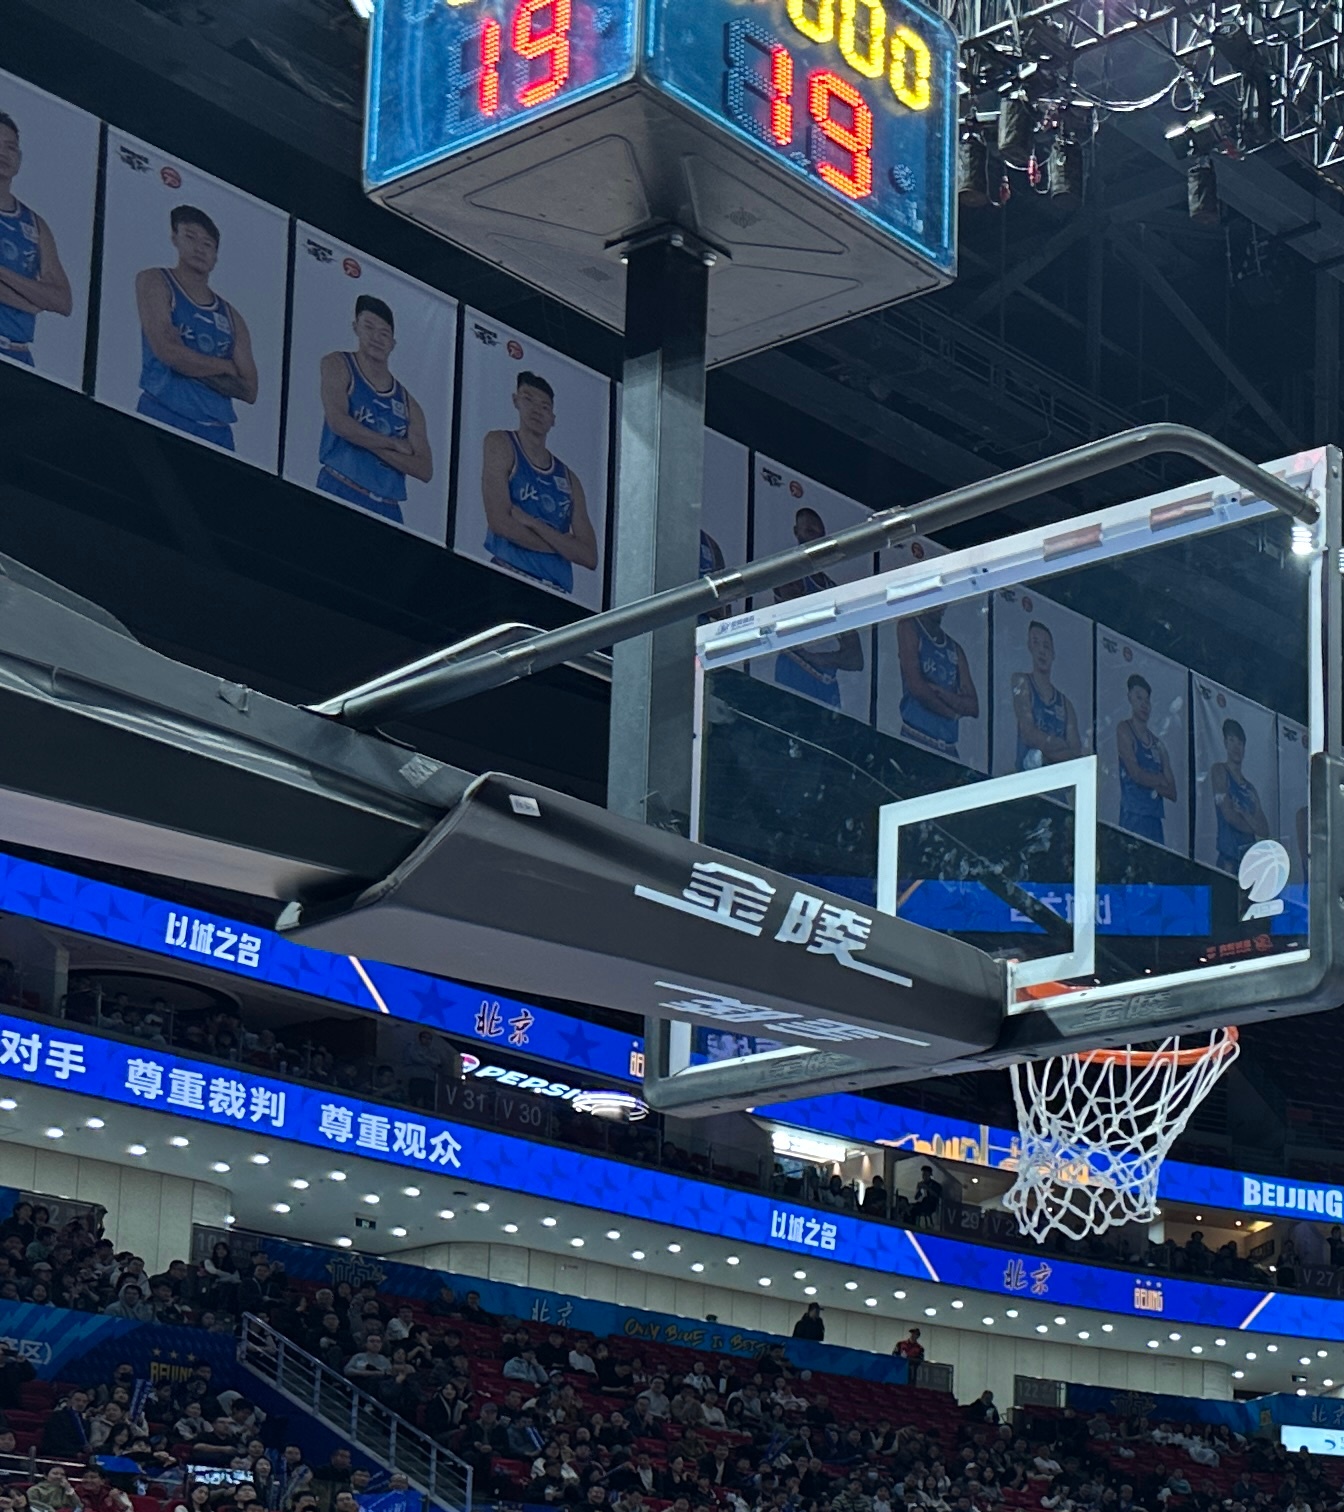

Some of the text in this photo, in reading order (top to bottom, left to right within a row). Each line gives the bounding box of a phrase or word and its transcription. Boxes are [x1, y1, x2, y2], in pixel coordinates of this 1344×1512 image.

[480, 0, 571, 117] 19
[770, 43, 873, 200] 19
[166, 911, 261, 968] 以城之名
[634, 861, 913, 988] 金陵
[474, 1000, 535, 1047] 北京
[125, 1058, 287, 1127] 尊重裁判
[318, 1102, 463, 1169] 尊重观众
[1243, 1177, 1343, 1218] BEIJING
[771, 1209, 837, 1251] 以城之名
[1003, 1260, 1052, 1294] 北京
